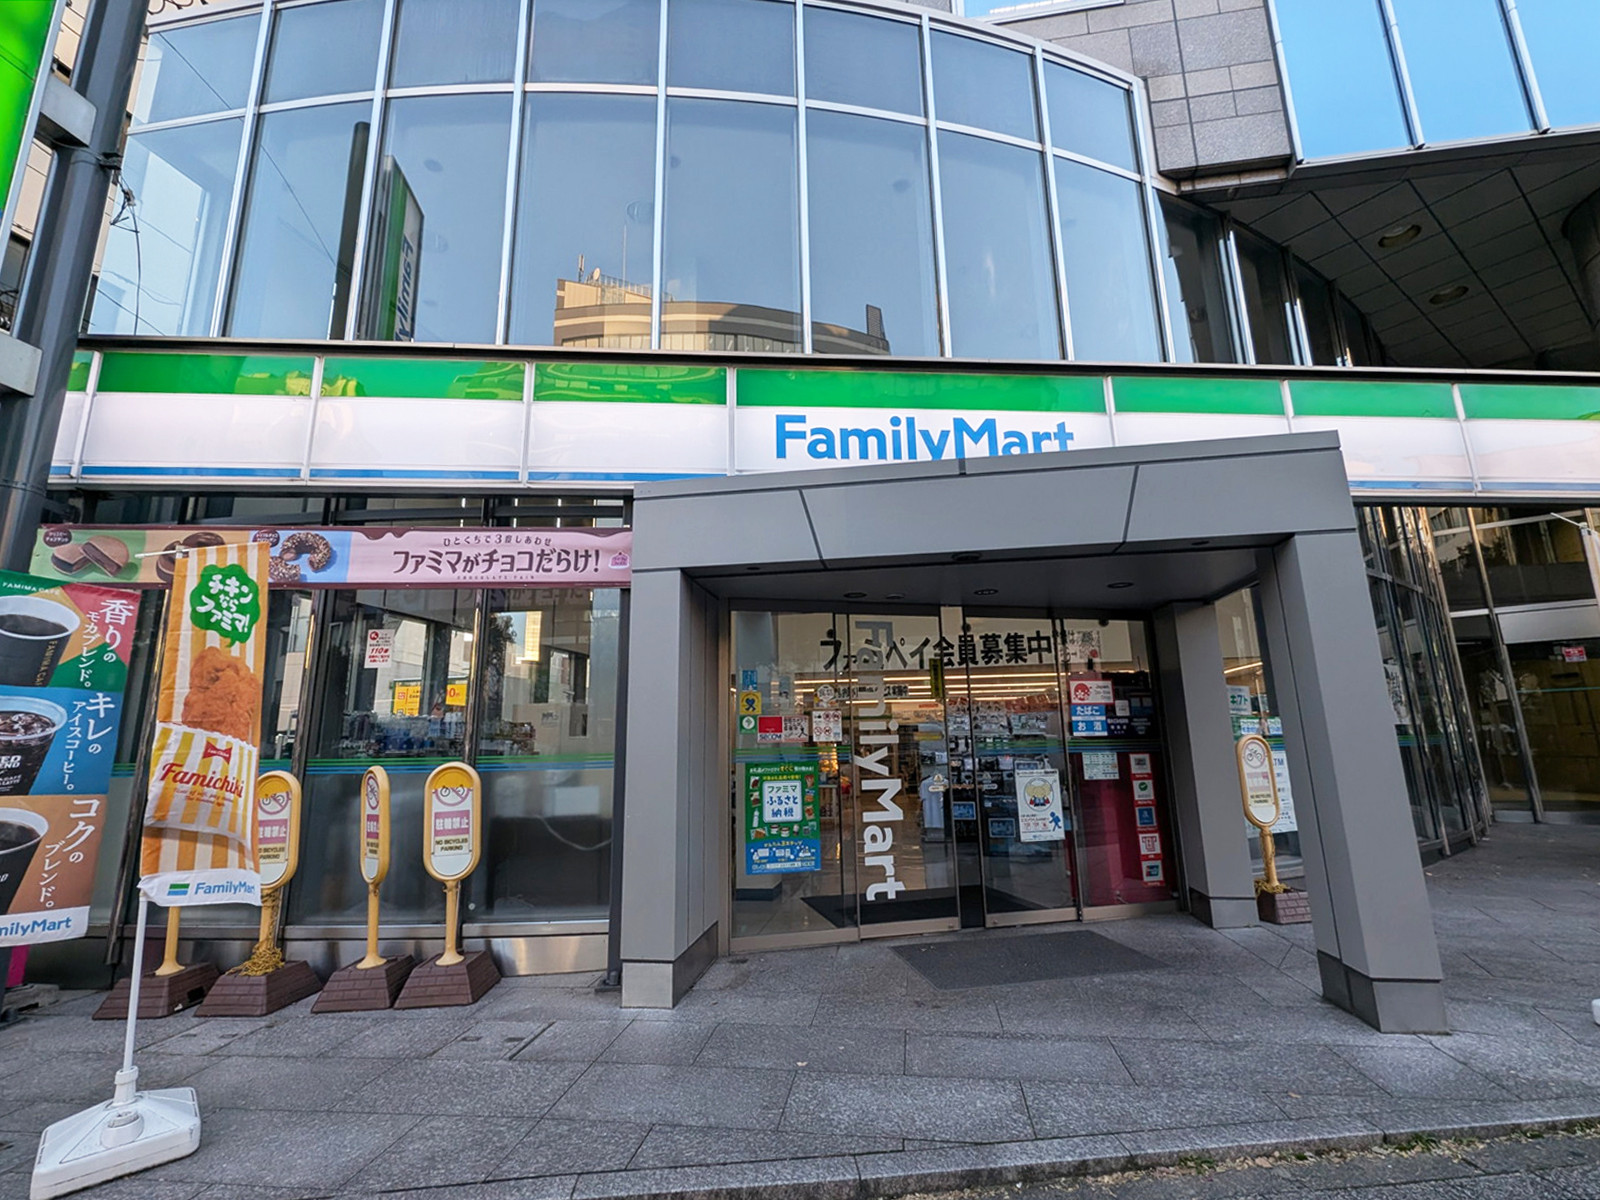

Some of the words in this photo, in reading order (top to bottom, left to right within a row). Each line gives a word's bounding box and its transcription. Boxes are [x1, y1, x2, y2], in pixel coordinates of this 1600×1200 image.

[775, 414, 1074, 461] FamilyMart
[393, 547, 600, 575] ファミマがチョコだらけ!
[208, 574, 253, 604] チキン
[219, 594, 239, 612] なら
[196, 595, 250, 633] ファミマ!
[99, 599, 135, 663] 香りの
[86, 692, 115, 754] キレの
[1075, 705, 1101, 715] たばこ
[853, 621, 906, 901] FamilyMart
[160, 762, 244, 798] Famichiki
[767, 785, 797, 793] ファミマ
[766, 795, 799, 805] ふるさと
[771, 808, 794, 817] 納税
[62, 799, 100, 863] コクの
